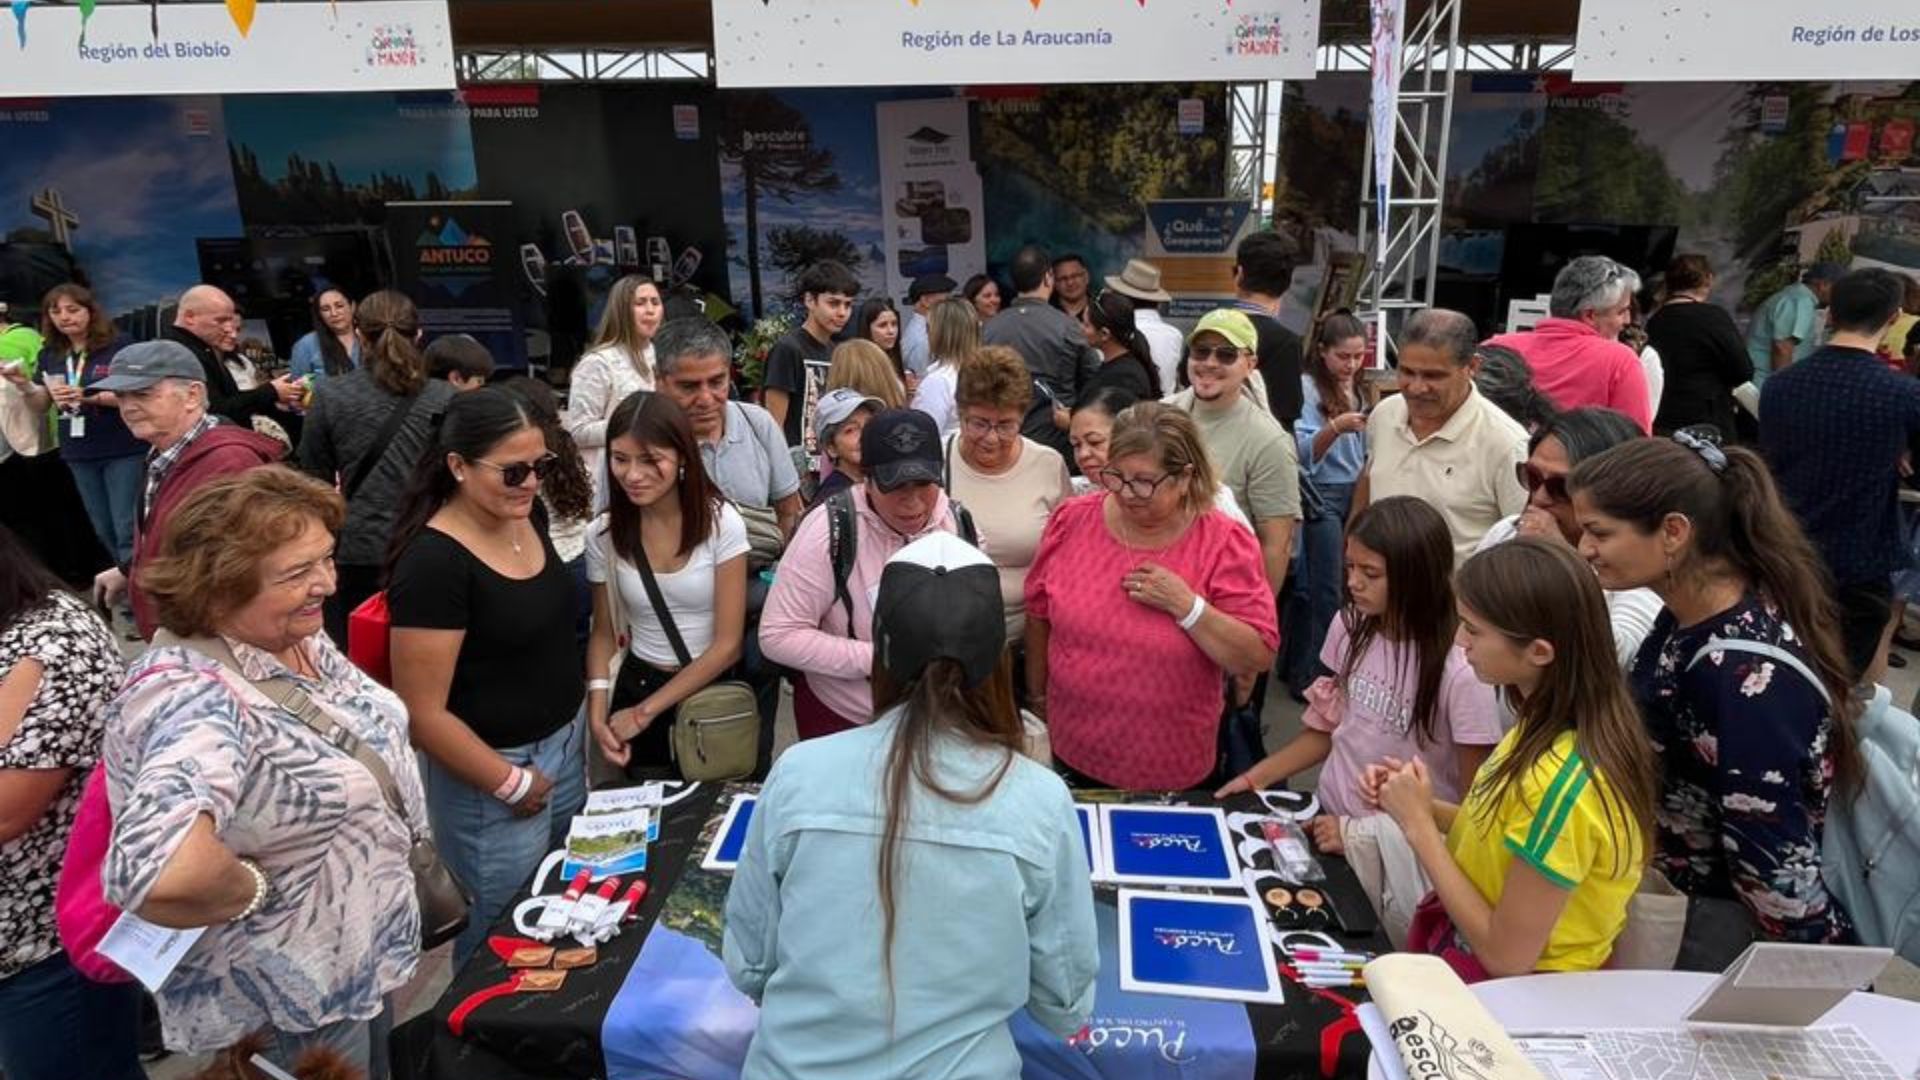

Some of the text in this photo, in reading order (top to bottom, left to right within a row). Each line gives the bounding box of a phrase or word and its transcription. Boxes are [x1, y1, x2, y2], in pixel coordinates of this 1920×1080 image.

[901, 28, 1113, 50] Región de La Araucanía
[1791, 25, 1920, 46] Región de Los
[79, 43, 138, 63] Región
[143, 42, 170, 58] del
[504, 107, 540, 118] USTED
[419, 248, 490, 264] ANTUCO
